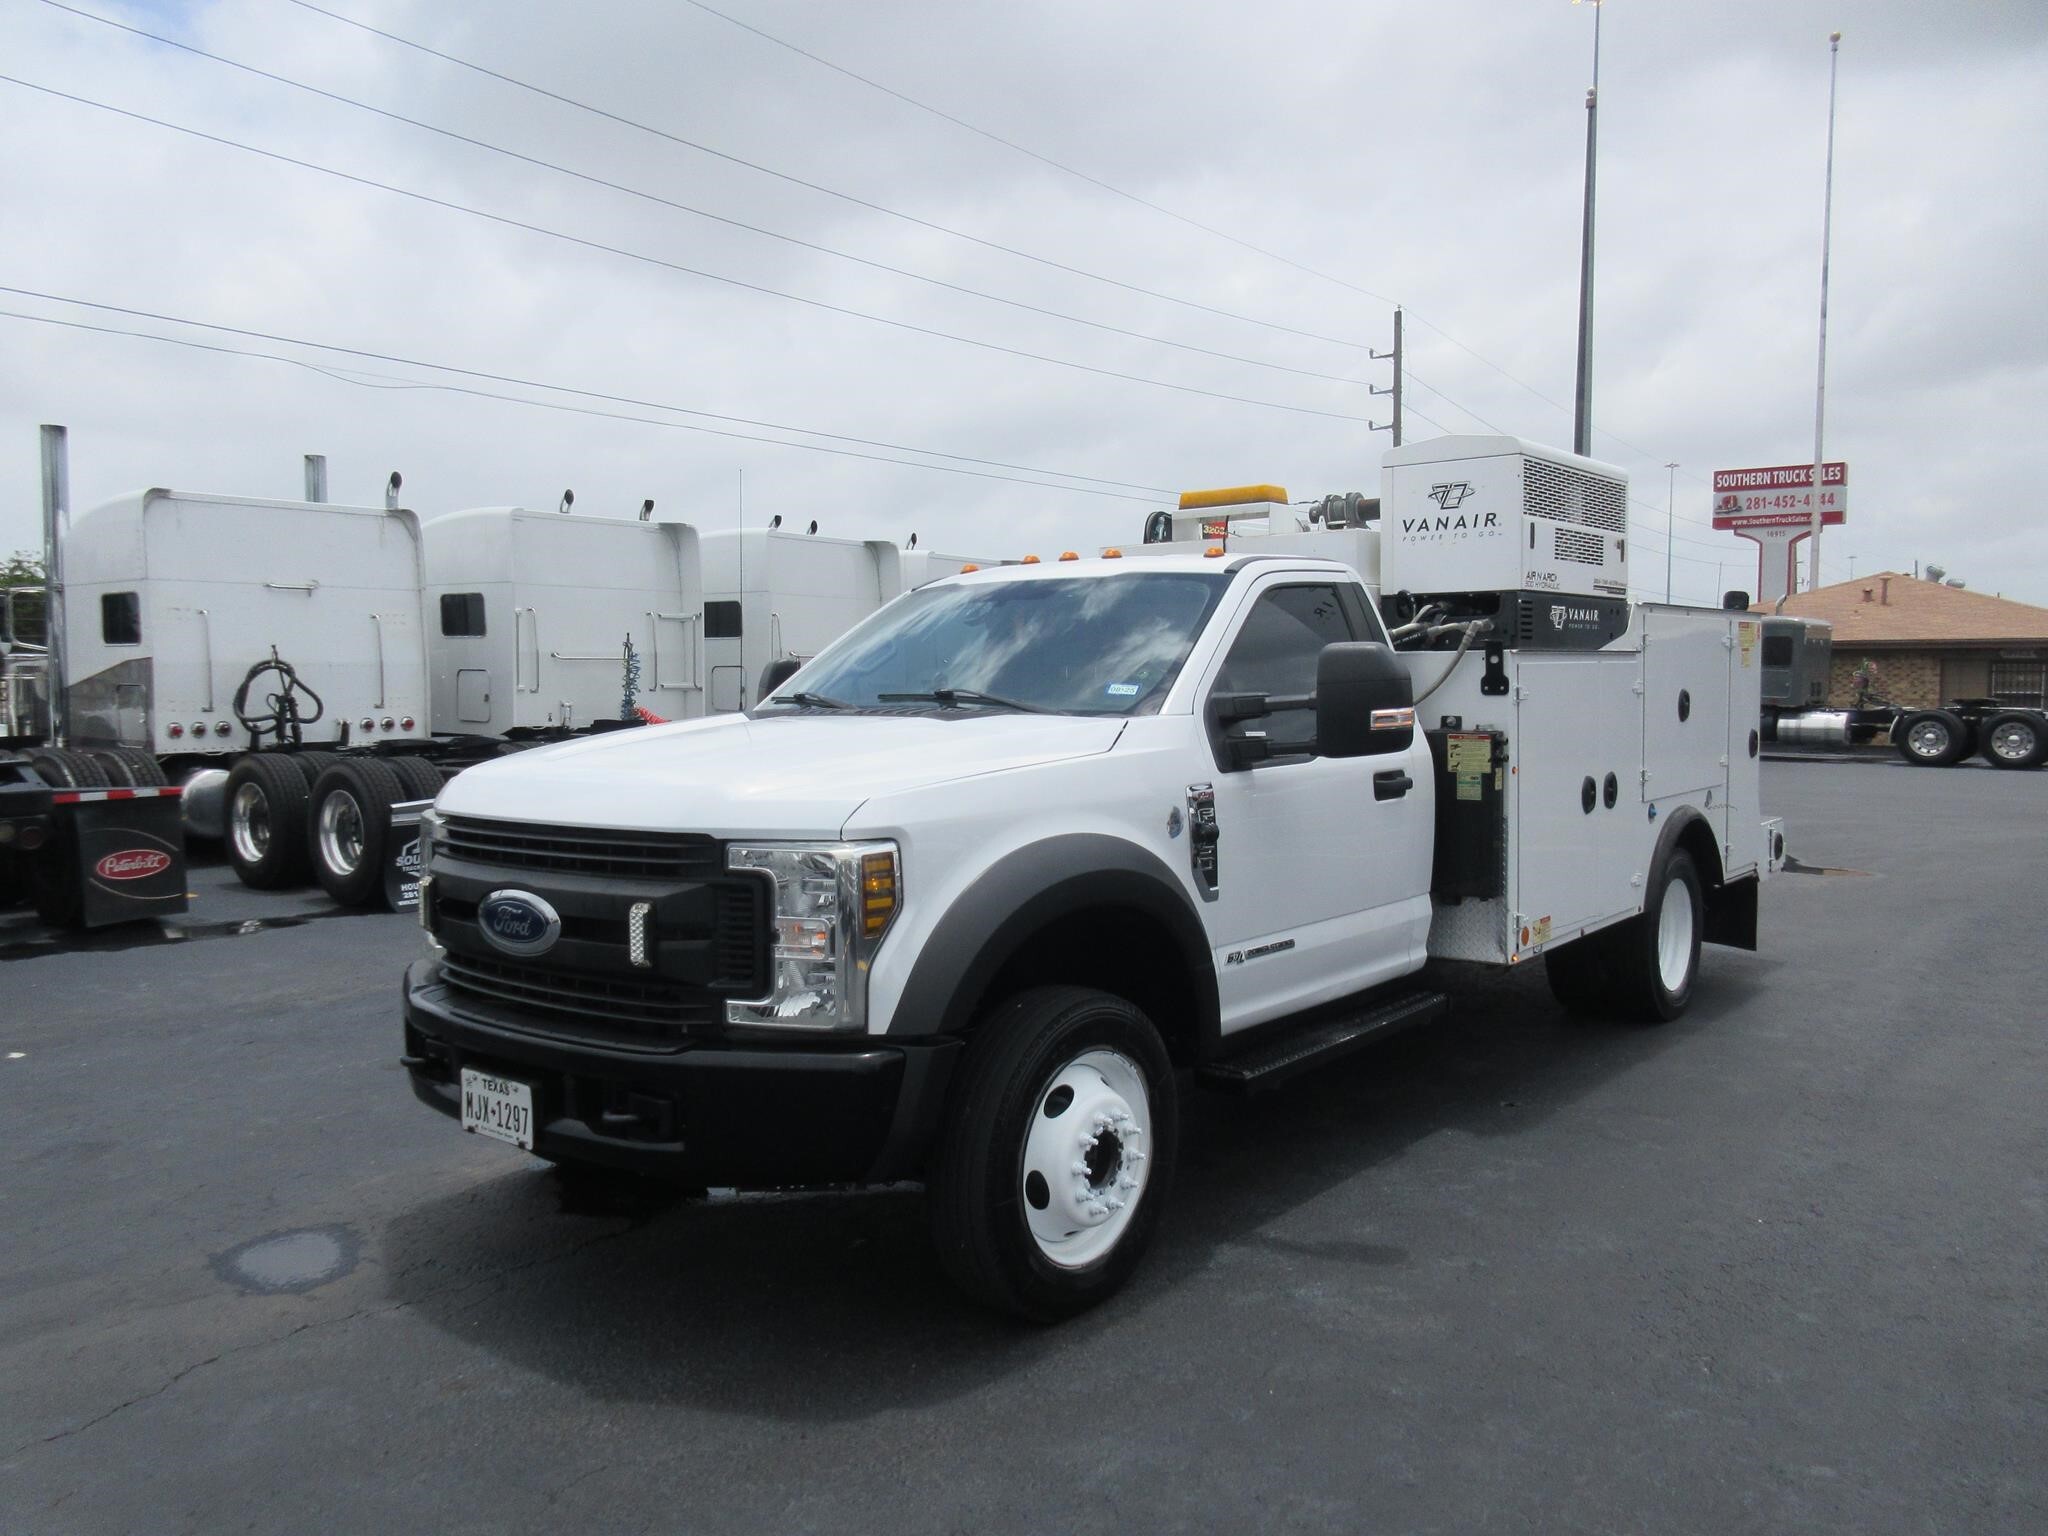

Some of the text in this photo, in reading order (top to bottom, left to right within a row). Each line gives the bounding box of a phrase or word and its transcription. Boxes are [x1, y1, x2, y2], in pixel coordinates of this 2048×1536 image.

[1716, 466, 1841, 488] SOUTHERN TRUCK SLES
[1745, 492, 1836, 510] 281-452-444
[1402, 512, 1497, 533] VANAIR
[1568, 607, 1599, 621] VANAIR
[105, 854, 164, 875] Peterbilt
[401, 882, 420, 891] HOU
[494, 905, 531, 936] Ford
[482, 1078, 511, 1096] TEXAS
